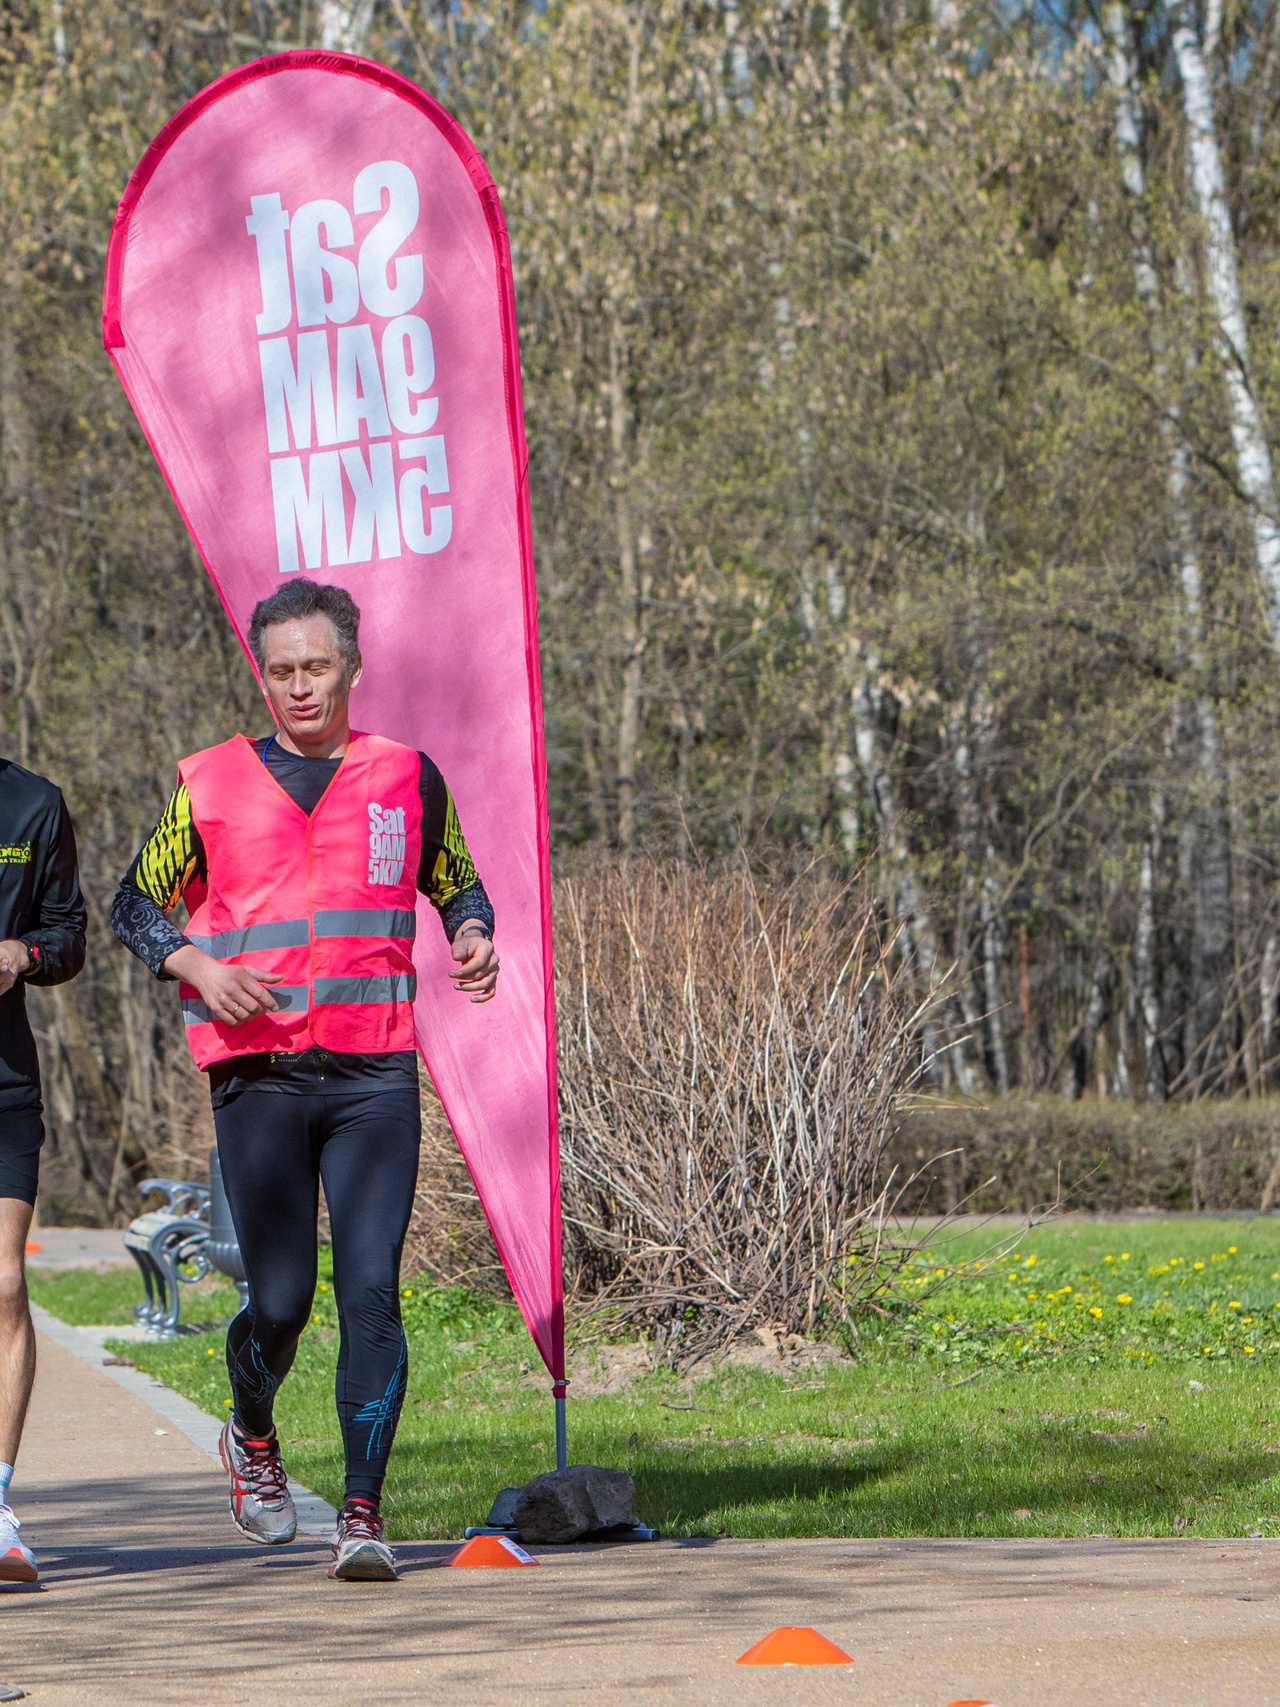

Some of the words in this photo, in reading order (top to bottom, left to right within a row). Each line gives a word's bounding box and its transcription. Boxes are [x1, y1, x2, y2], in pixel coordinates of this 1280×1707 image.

[367, 802, 406, 835] Sat
[369, 834, 406, 861] 9AM
[368, 858, 405, 886] 5KM
